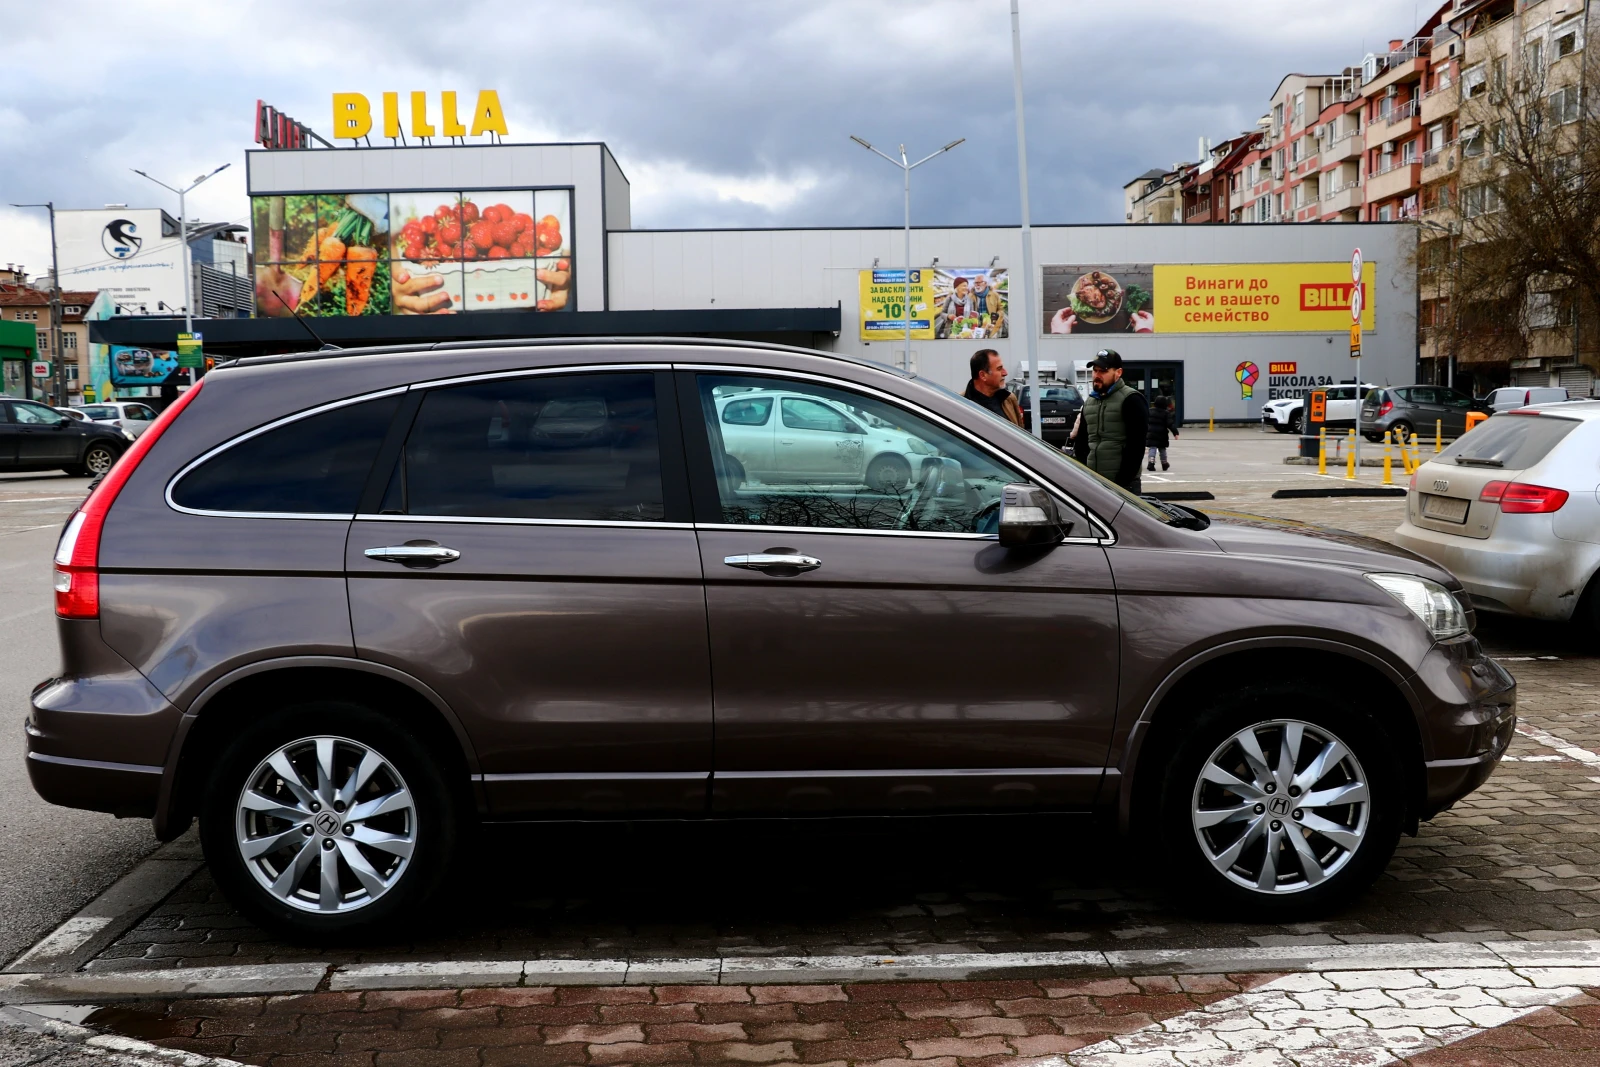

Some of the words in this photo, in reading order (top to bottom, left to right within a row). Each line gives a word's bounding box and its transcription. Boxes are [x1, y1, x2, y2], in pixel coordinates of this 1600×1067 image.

[332, 89, 509, 139] BILLA
[1186, 276, 1244, 290] Винаги
[1249, 279, 1268, 291] до
[872, 296, 886, 304] НАД
[1174, 295, 1201, 306] вас
[1206, 295, 1215, 306] и
[1220, 294, 1280, 306] вашето
[877, 303, 917, 318] -10%
[1184, 308, 1270, 322] семейство
[1271, 363, 1295, 372] BILLA
[1269, 376, 1316, 387] ШКОЛА
[1317, 375, 1334, 386] ЗА
